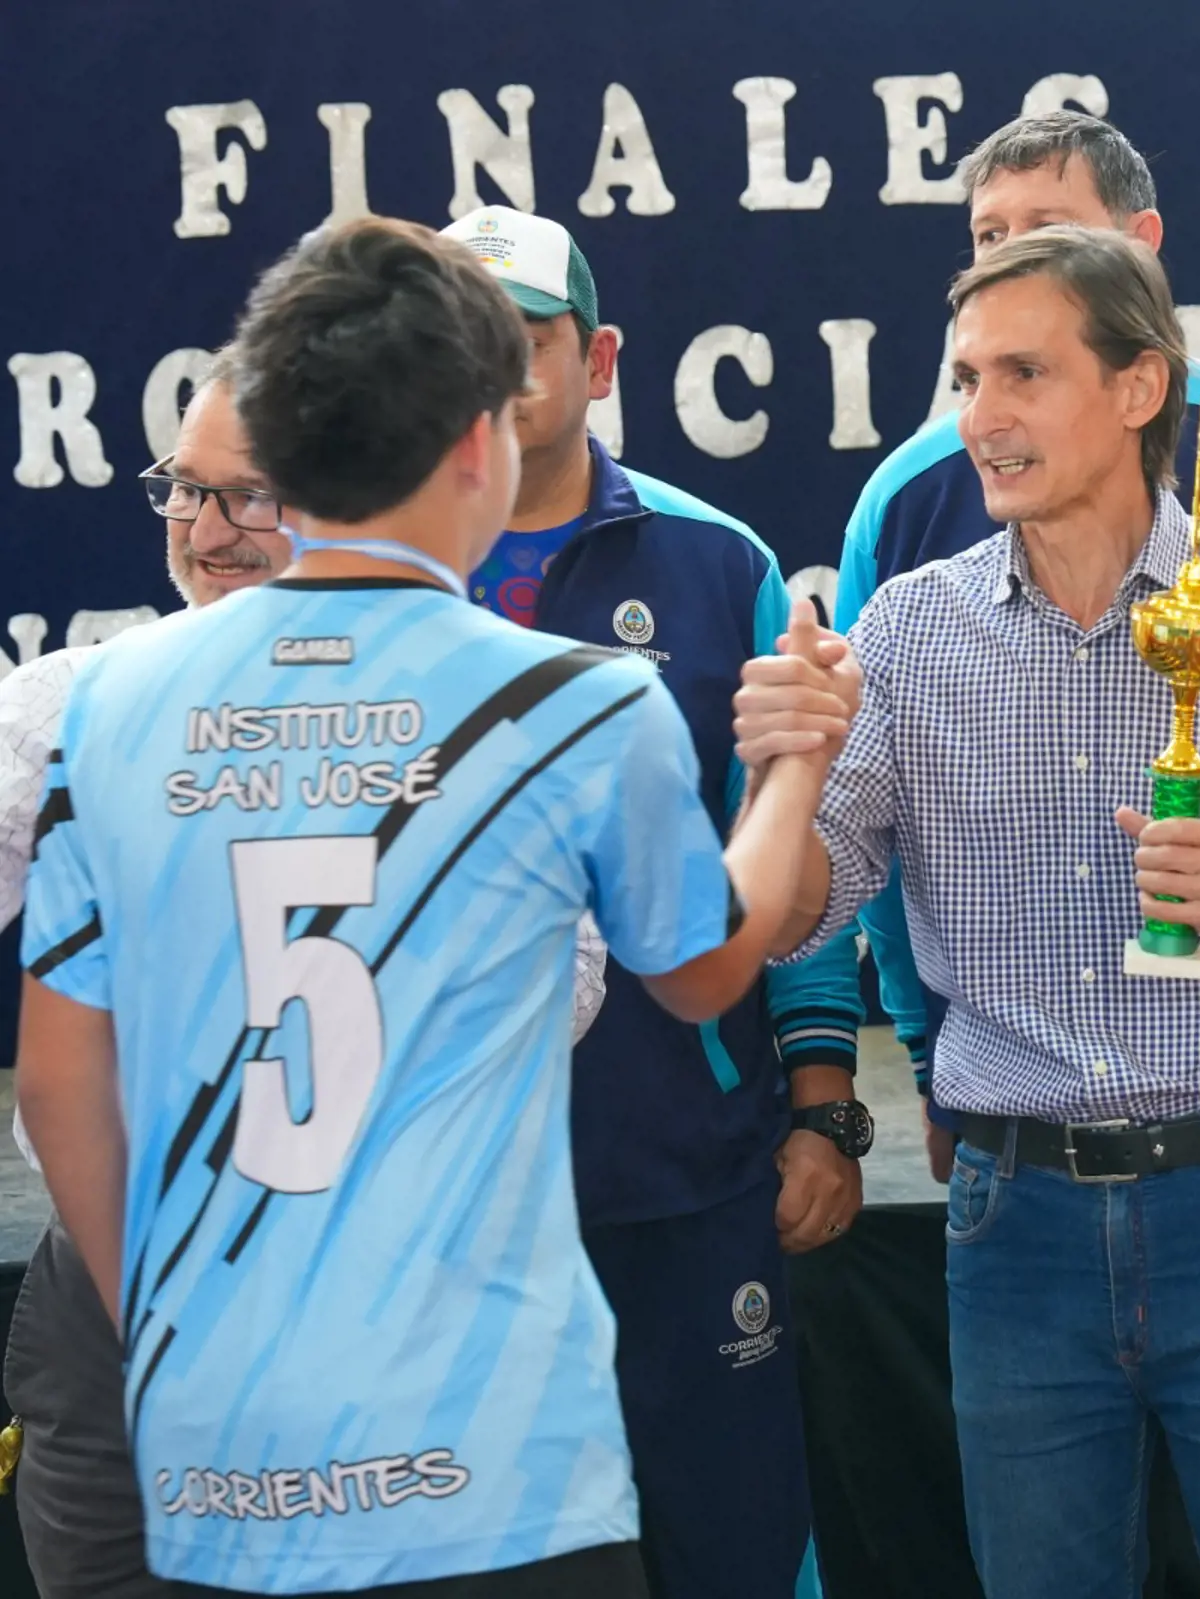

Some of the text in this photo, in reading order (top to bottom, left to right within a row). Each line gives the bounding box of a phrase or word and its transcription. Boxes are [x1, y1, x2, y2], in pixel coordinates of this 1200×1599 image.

[185, 700, 424, 754] INSTITUTO
[164, 745, 444, 817] SAN JOSÉ
[228, 834, 386, 1195] 5
[155, 1448, 471, 1522] CORRIENTES
